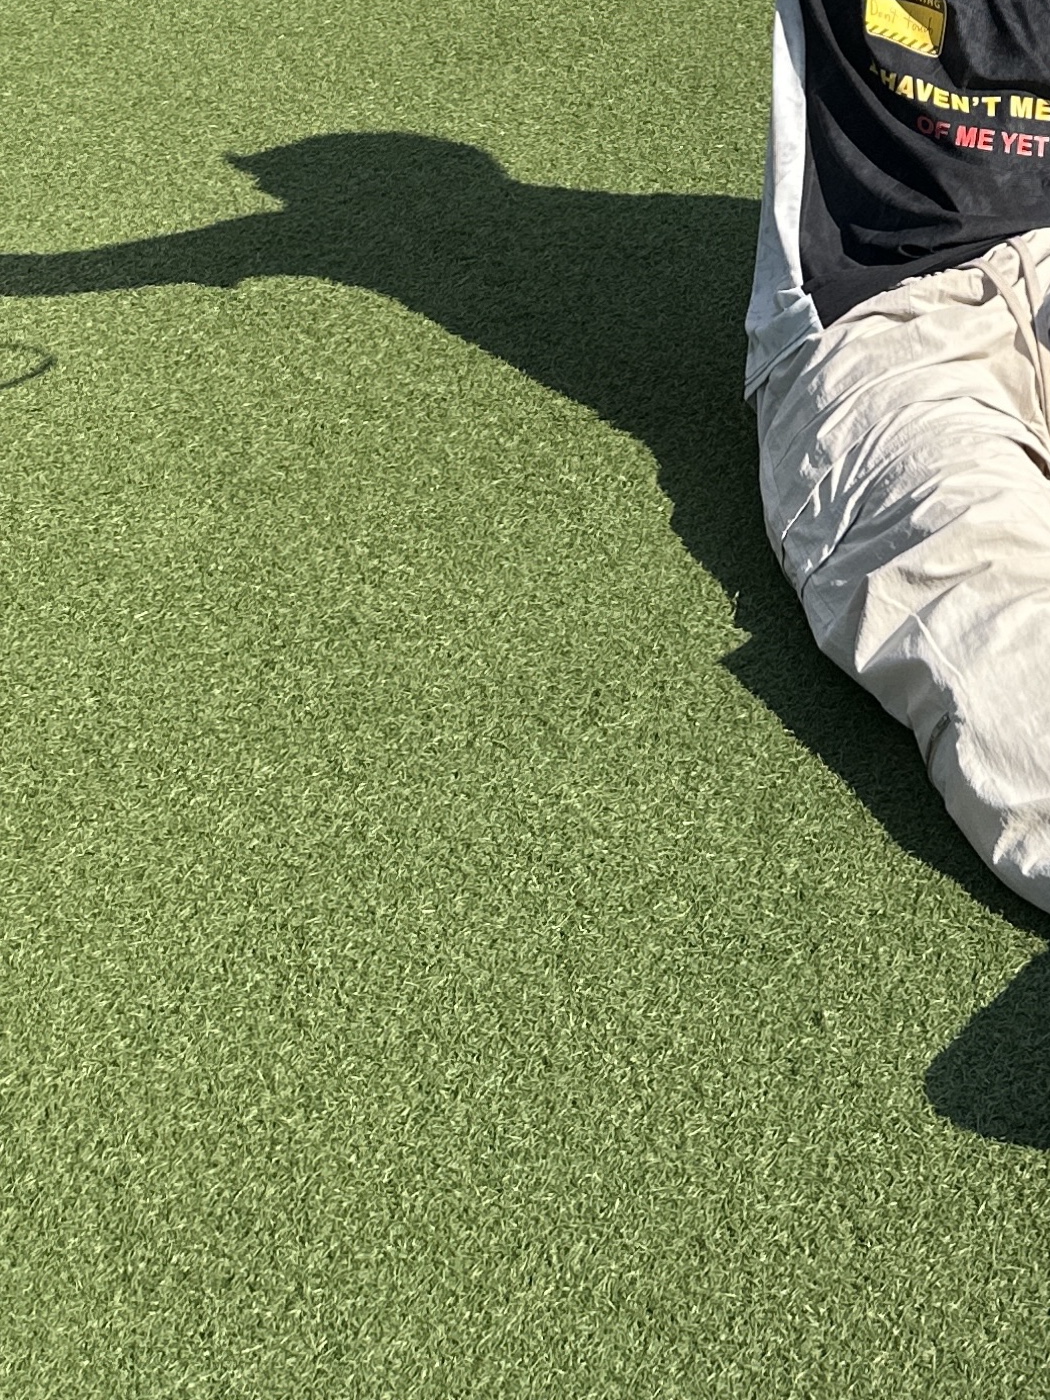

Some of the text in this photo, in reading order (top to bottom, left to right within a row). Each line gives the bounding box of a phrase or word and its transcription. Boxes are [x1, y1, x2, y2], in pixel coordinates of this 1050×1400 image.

[916, 114, 1050, 157] OF ME YET
